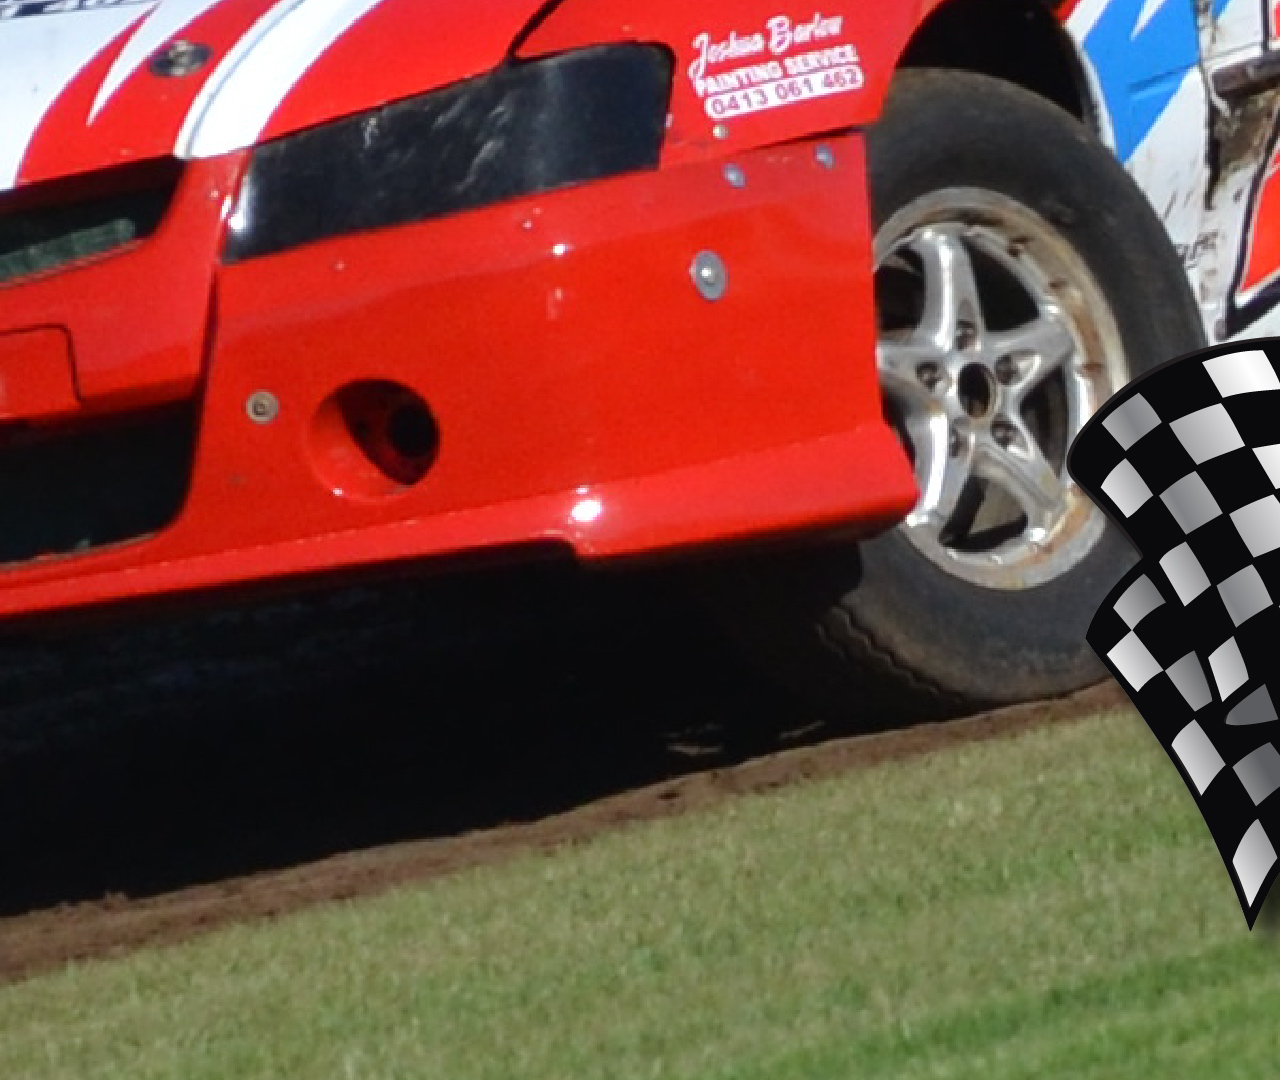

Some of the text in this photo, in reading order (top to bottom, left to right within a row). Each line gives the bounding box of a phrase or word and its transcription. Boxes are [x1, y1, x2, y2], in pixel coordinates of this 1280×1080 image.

[694, 43, 859, 98] PAINTING SERVICE
[710, 88, 769, 115] 0413
[774, 76, 815, 101] 061
